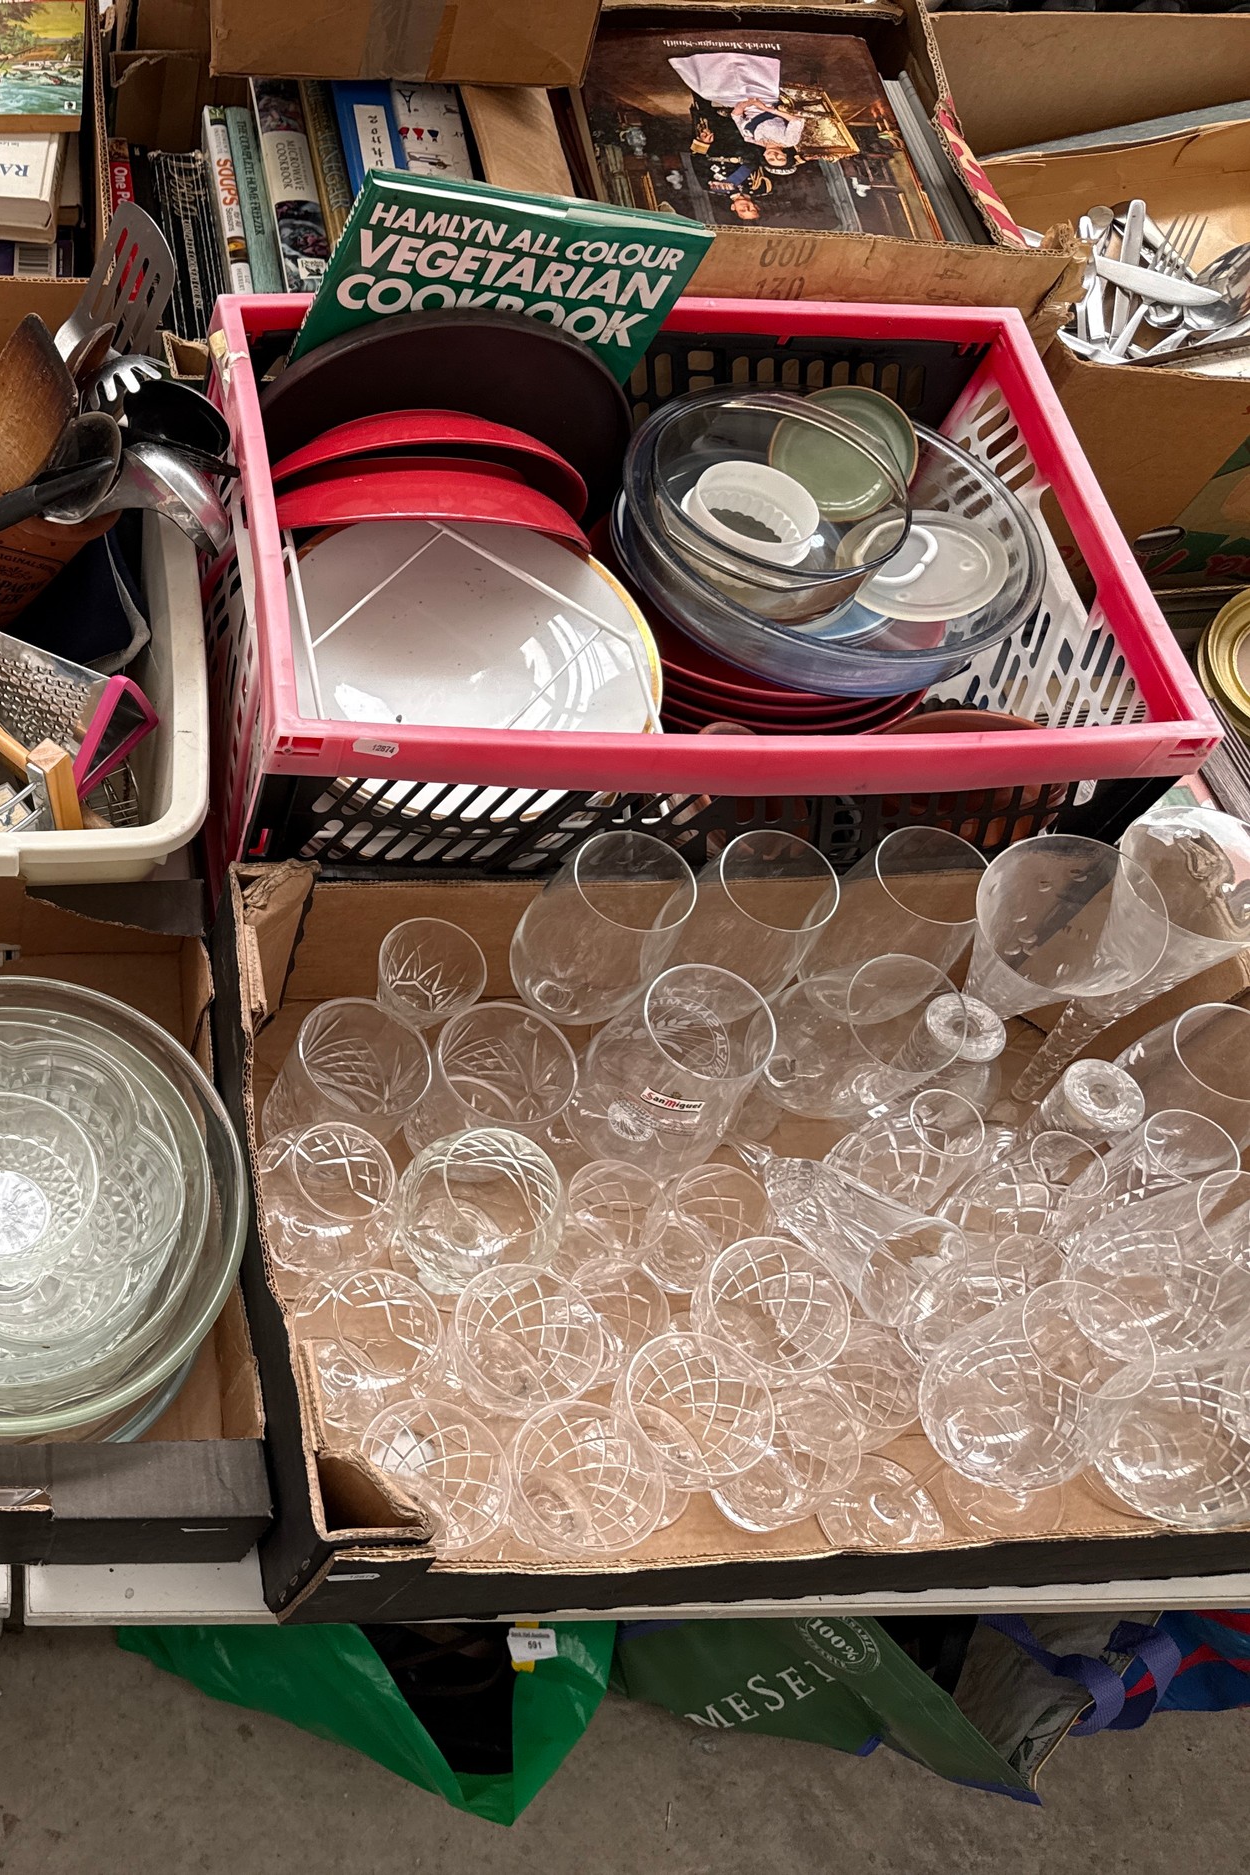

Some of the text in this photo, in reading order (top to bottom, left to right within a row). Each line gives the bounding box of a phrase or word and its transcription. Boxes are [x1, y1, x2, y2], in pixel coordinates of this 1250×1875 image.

[114, 167, 129, 190] One
[216, 158, 239, 206] SOUPS
[236, 121, 265, 236] THE COMPLETE HOME FREEZER
[275, 142, 293, 190] COOKBOOK
[286, 140, 305, 191] MICROWAVE
[317, 131, 350, 213] VINEGAR
[225, 207, 236, 232] Seasons
[368, 202, 685, 271] HAMLYN ALL COLOUR
[236, 267, 246, 291] HERBERT
[358, 229, 673, 310] VEGETARIAN
[372, 744, 396, 754] 12874
[642, 1091, 703, 1110] SanMiguel
[810, 1618, 859, 1662] 100%
